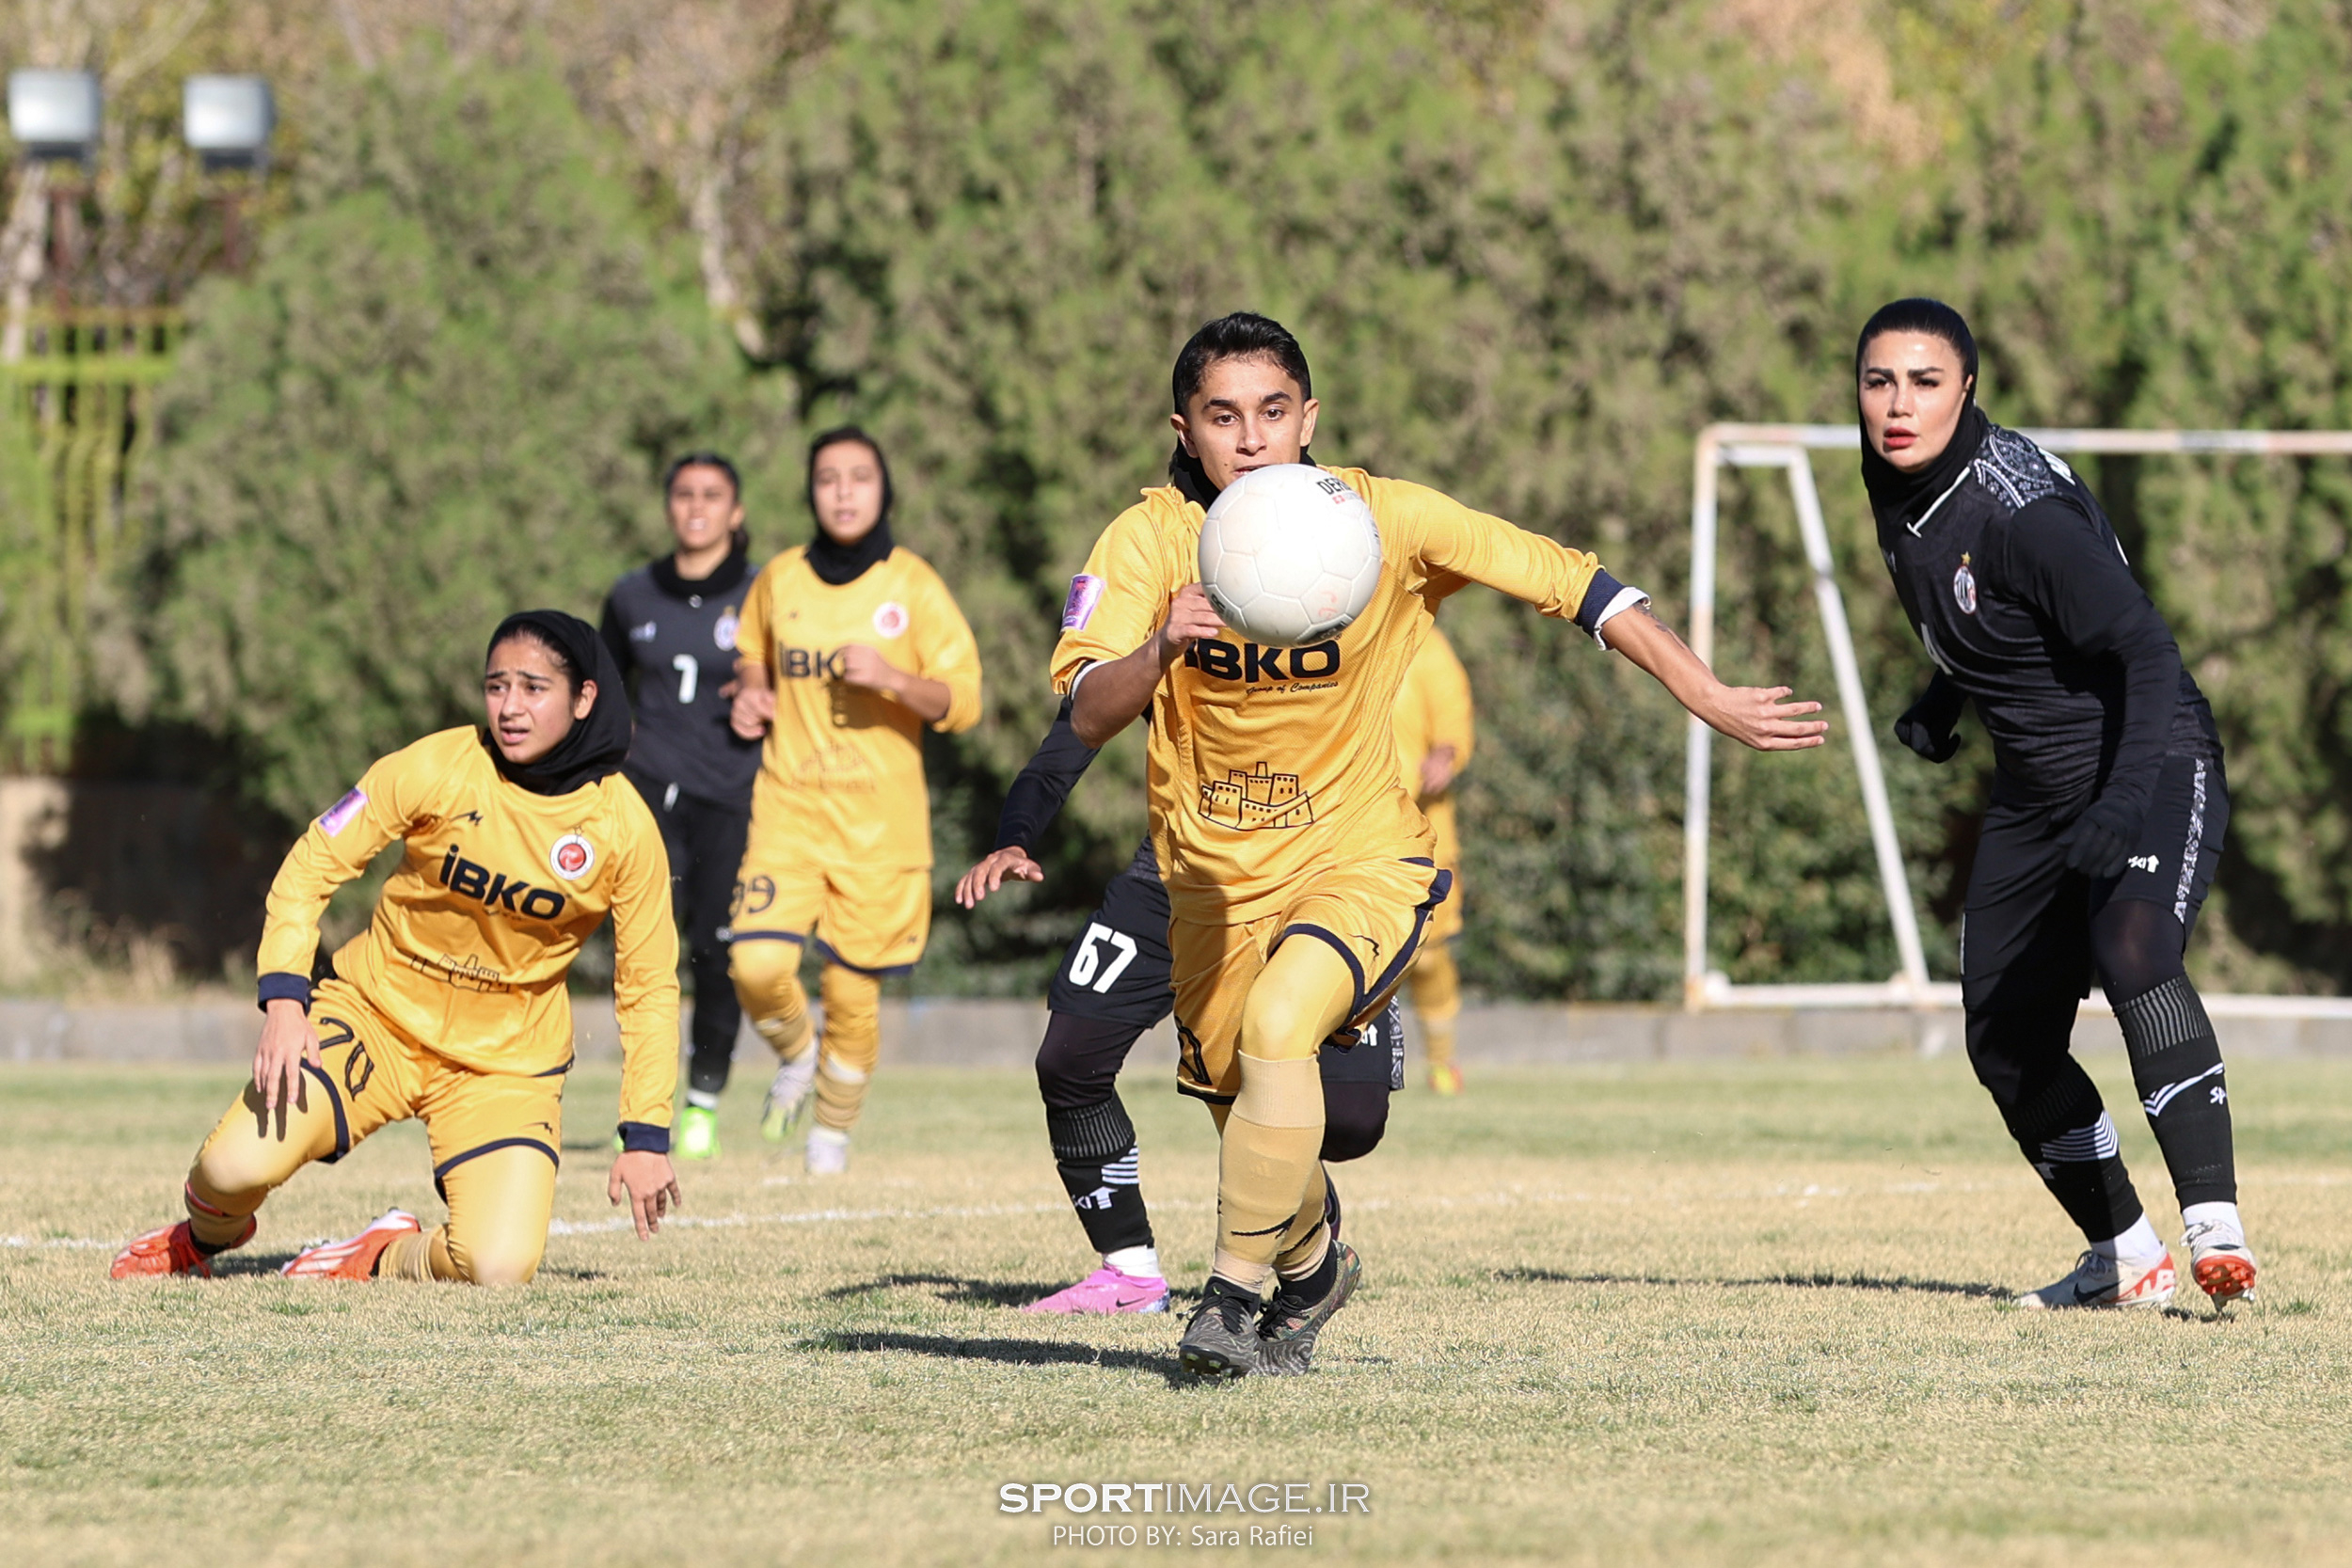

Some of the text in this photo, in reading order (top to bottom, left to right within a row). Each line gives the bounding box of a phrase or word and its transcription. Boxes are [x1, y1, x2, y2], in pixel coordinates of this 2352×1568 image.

[673, 654, 698, 704] 7
[439, 844, 565, 920] iBKO
[1069, 922, 1137, 993] 67
[319, 1017, 374, 1102] 70
